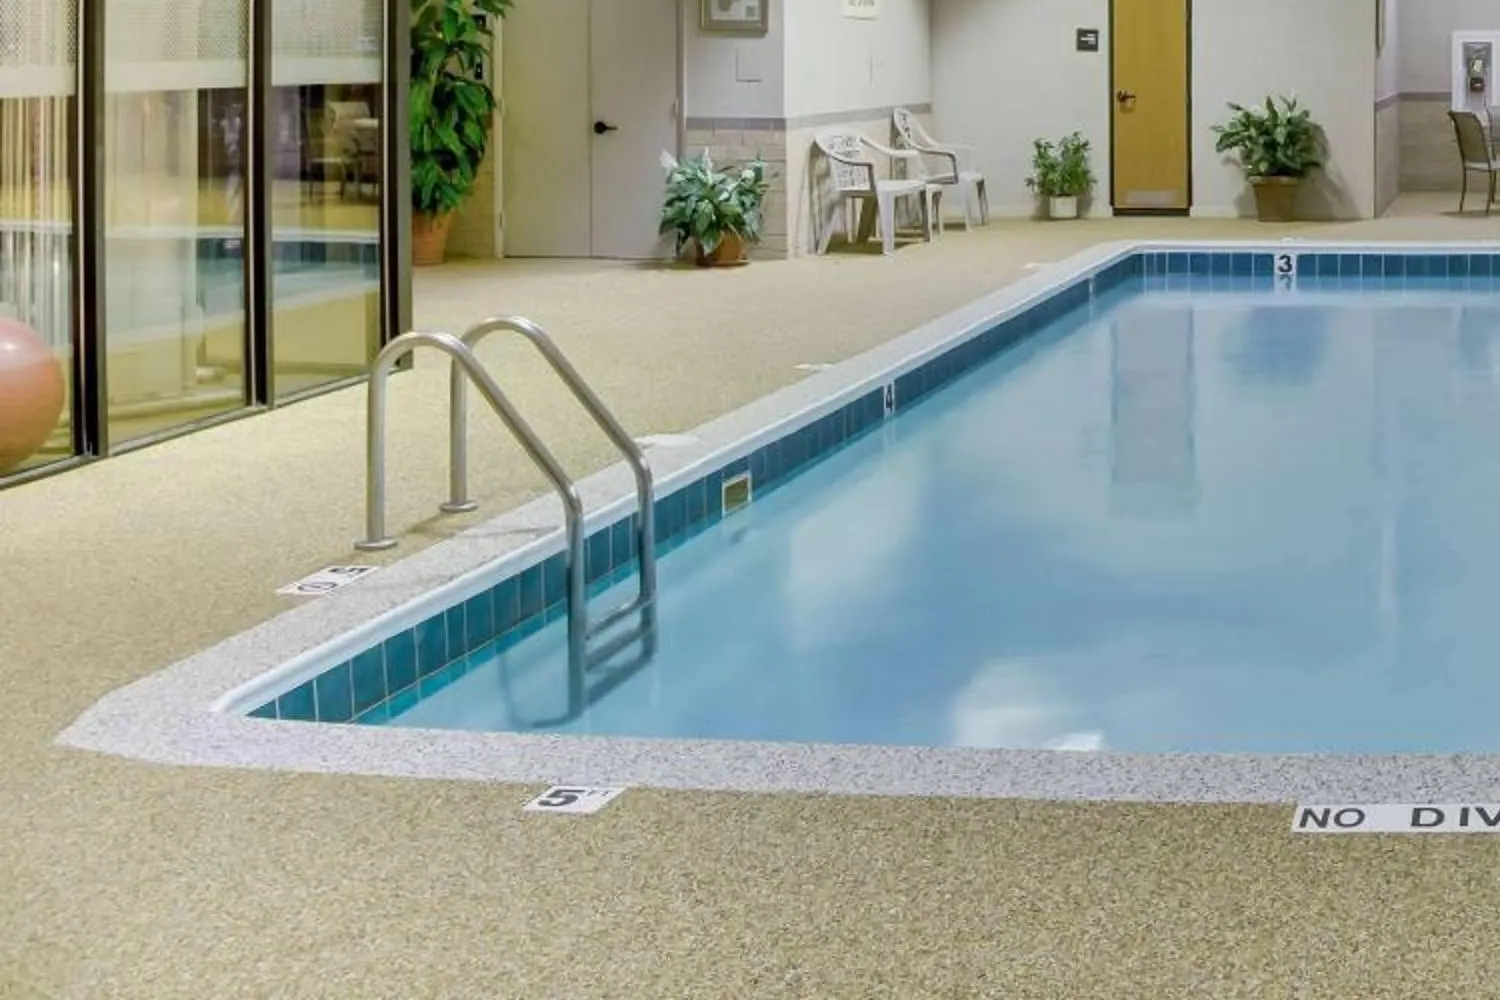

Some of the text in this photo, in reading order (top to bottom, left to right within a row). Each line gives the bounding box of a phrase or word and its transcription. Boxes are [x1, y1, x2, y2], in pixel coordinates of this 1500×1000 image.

[1278, 254, 1292, 273] 3
[537, 789, 586, 807] 5
[1299, 807, 1366, 829] NO
